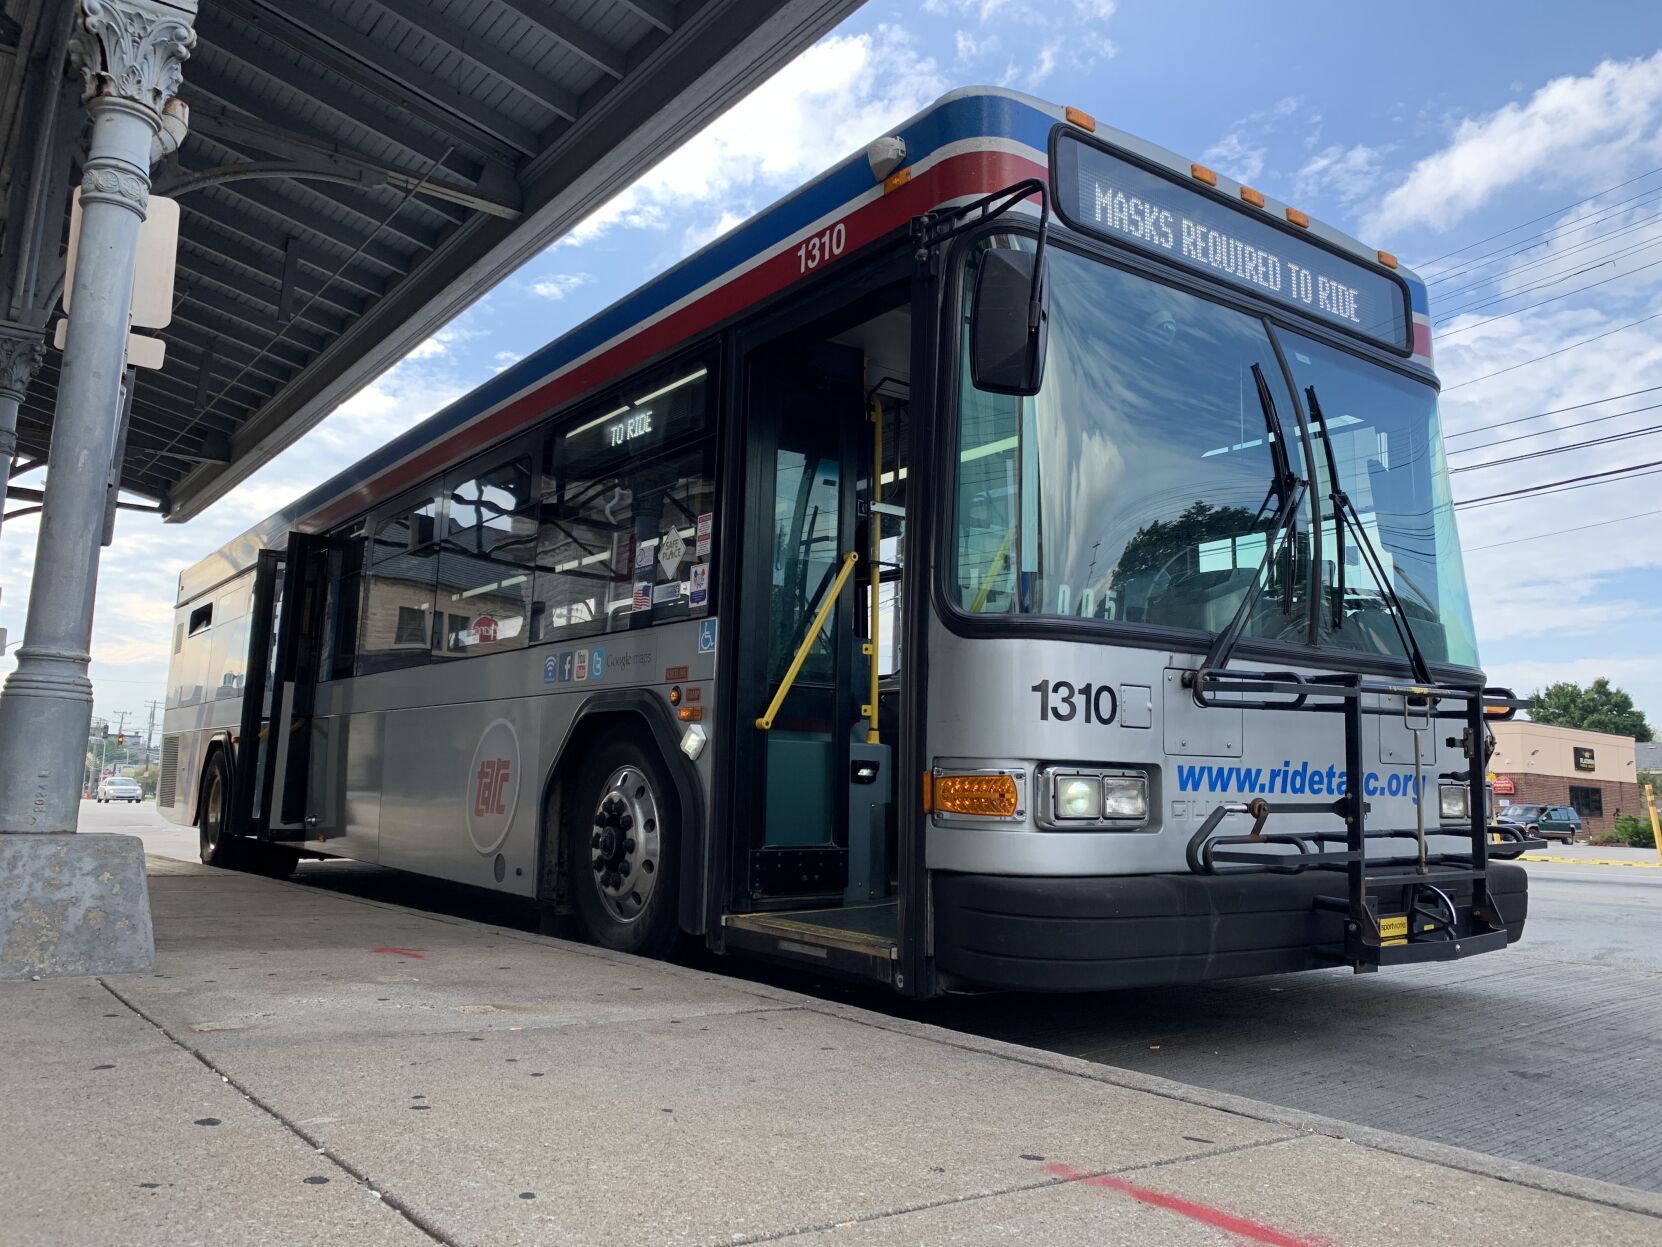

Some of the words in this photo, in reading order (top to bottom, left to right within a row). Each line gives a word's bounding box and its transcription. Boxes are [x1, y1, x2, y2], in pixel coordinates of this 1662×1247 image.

[797, 223, 846, 274] 1310
[1095, 182, 1174, 249] MASKS
[1182, 217, 1282, 292] REQUIRED
[1287, 262, 1313, 304] TO
[1318, 274, 1360, 323] RIDE
[610, 423, 624, 447] TO
[626, 410, 653, 440] RIDE
[662, 547, 682, 561] PLACE
[665, 538, 679, 551] SAFE
[606, 653, 633, 671] Google
[1031, 679, 1117, 725] 1310
[1177, 760, 1426, 805] www.ridetac.org
